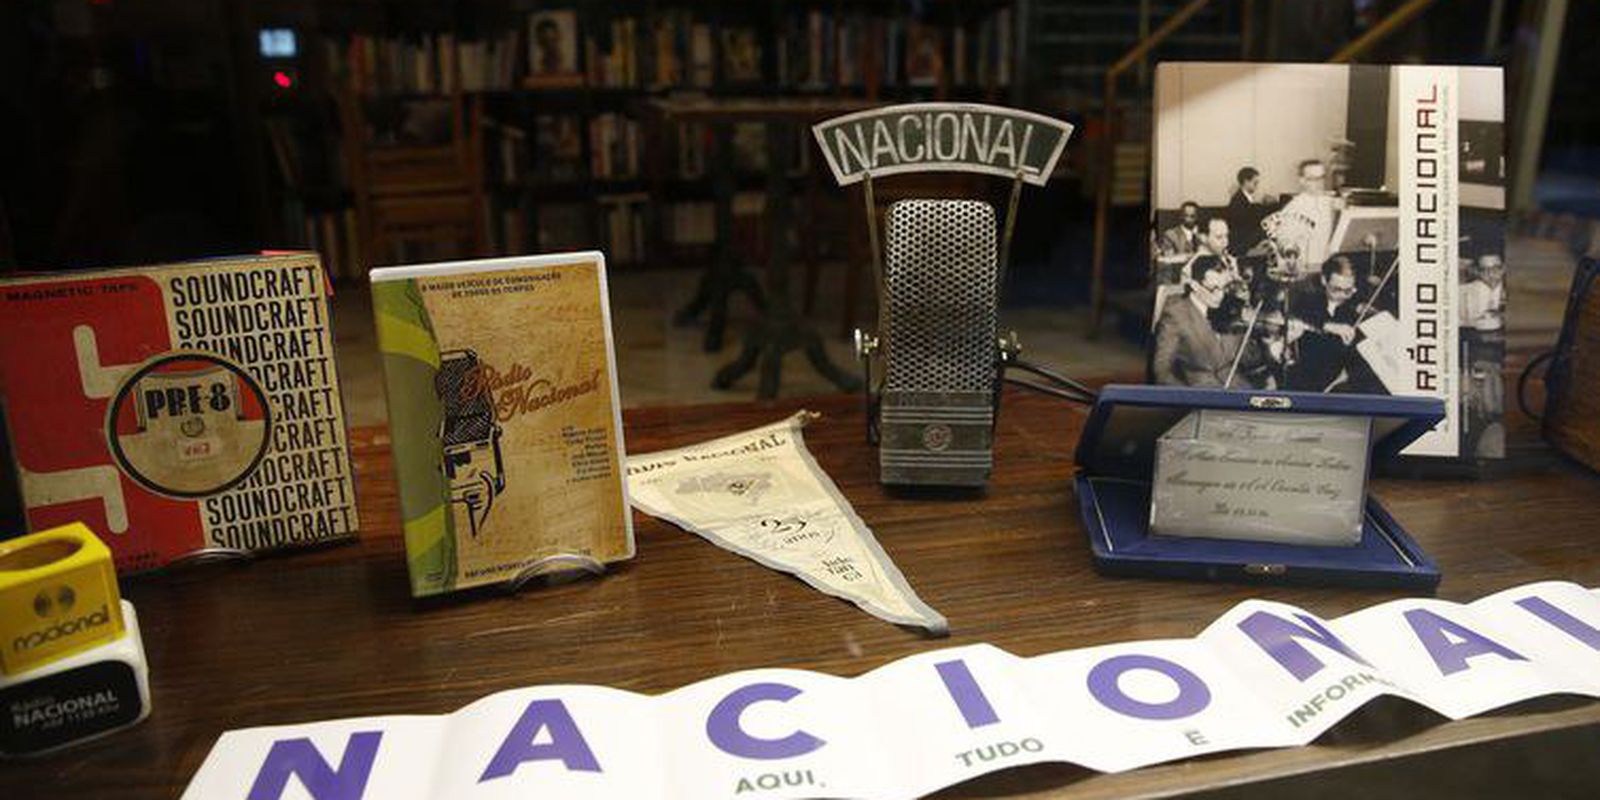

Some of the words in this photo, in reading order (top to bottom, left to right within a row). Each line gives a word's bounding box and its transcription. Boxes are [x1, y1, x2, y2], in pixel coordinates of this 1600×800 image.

[834, 112, 1041, 174] NACIONAL
[1415, 84, 1438, 265] NACIONAL
[170, 266, 317, 307] SOUNDCRAFT
[176, 297, 320, 340] SOUNDCRAFT
[1406, 283, 1438, 392] RÁDIO
[145, 382, 231, 419] PRE-8
[496, 368, 600, 422] Nacional
[206, 477, 347, 526] SOUNDCRAFT
[211, 506, 351, 550] SOUNDCRAFT
[13, 604, 110, 652] nacional
[13, 689, 119, 729] NACIONAL
[954, 737, 1044, 768] TUDO
